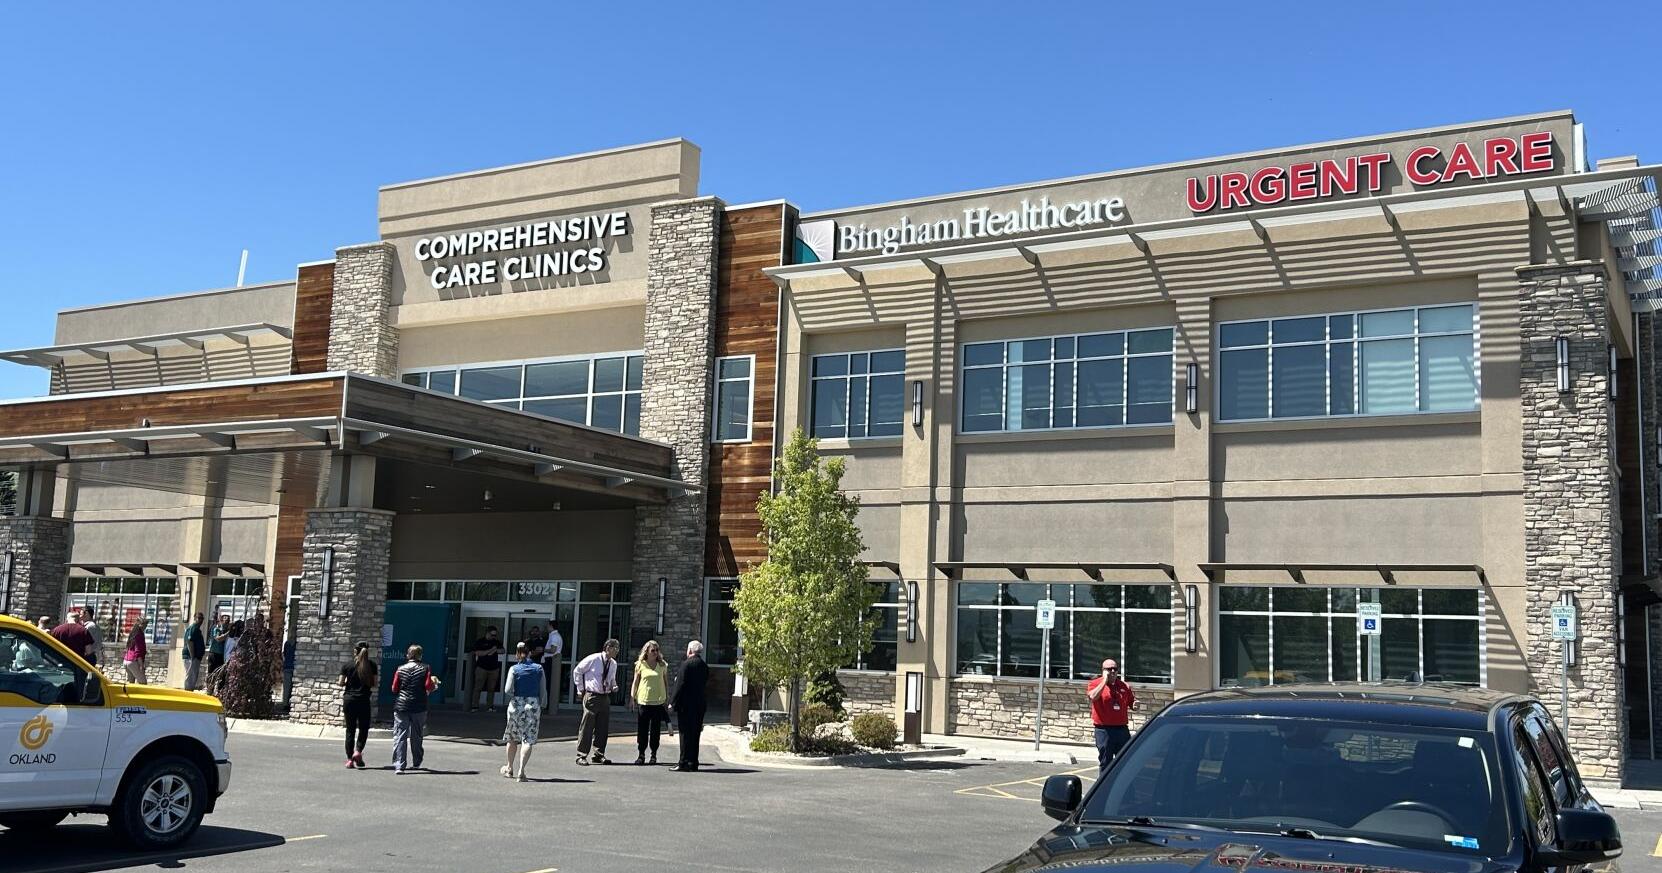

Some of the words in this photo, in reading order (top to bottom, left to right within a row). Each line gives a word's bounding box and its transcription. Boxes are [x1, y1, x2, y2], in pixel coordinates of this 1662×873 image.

[1185, 152, 1390, 213] URGENT
[1405, 132, 1554, 185] CARE
[415, 211, 628, 261] COMPREHENSIVE
[838, 216, 960, 256] Bingham
[962, 195, 1126, 239] Healthcare
[431, 260, 496, 289] CARE
[503, 248, 604, 281] CLINICS
[518, 582, 550, 595] 3302
[115, 713, 132, 723] 553
[9, 753, 57, 765] OKLAND
